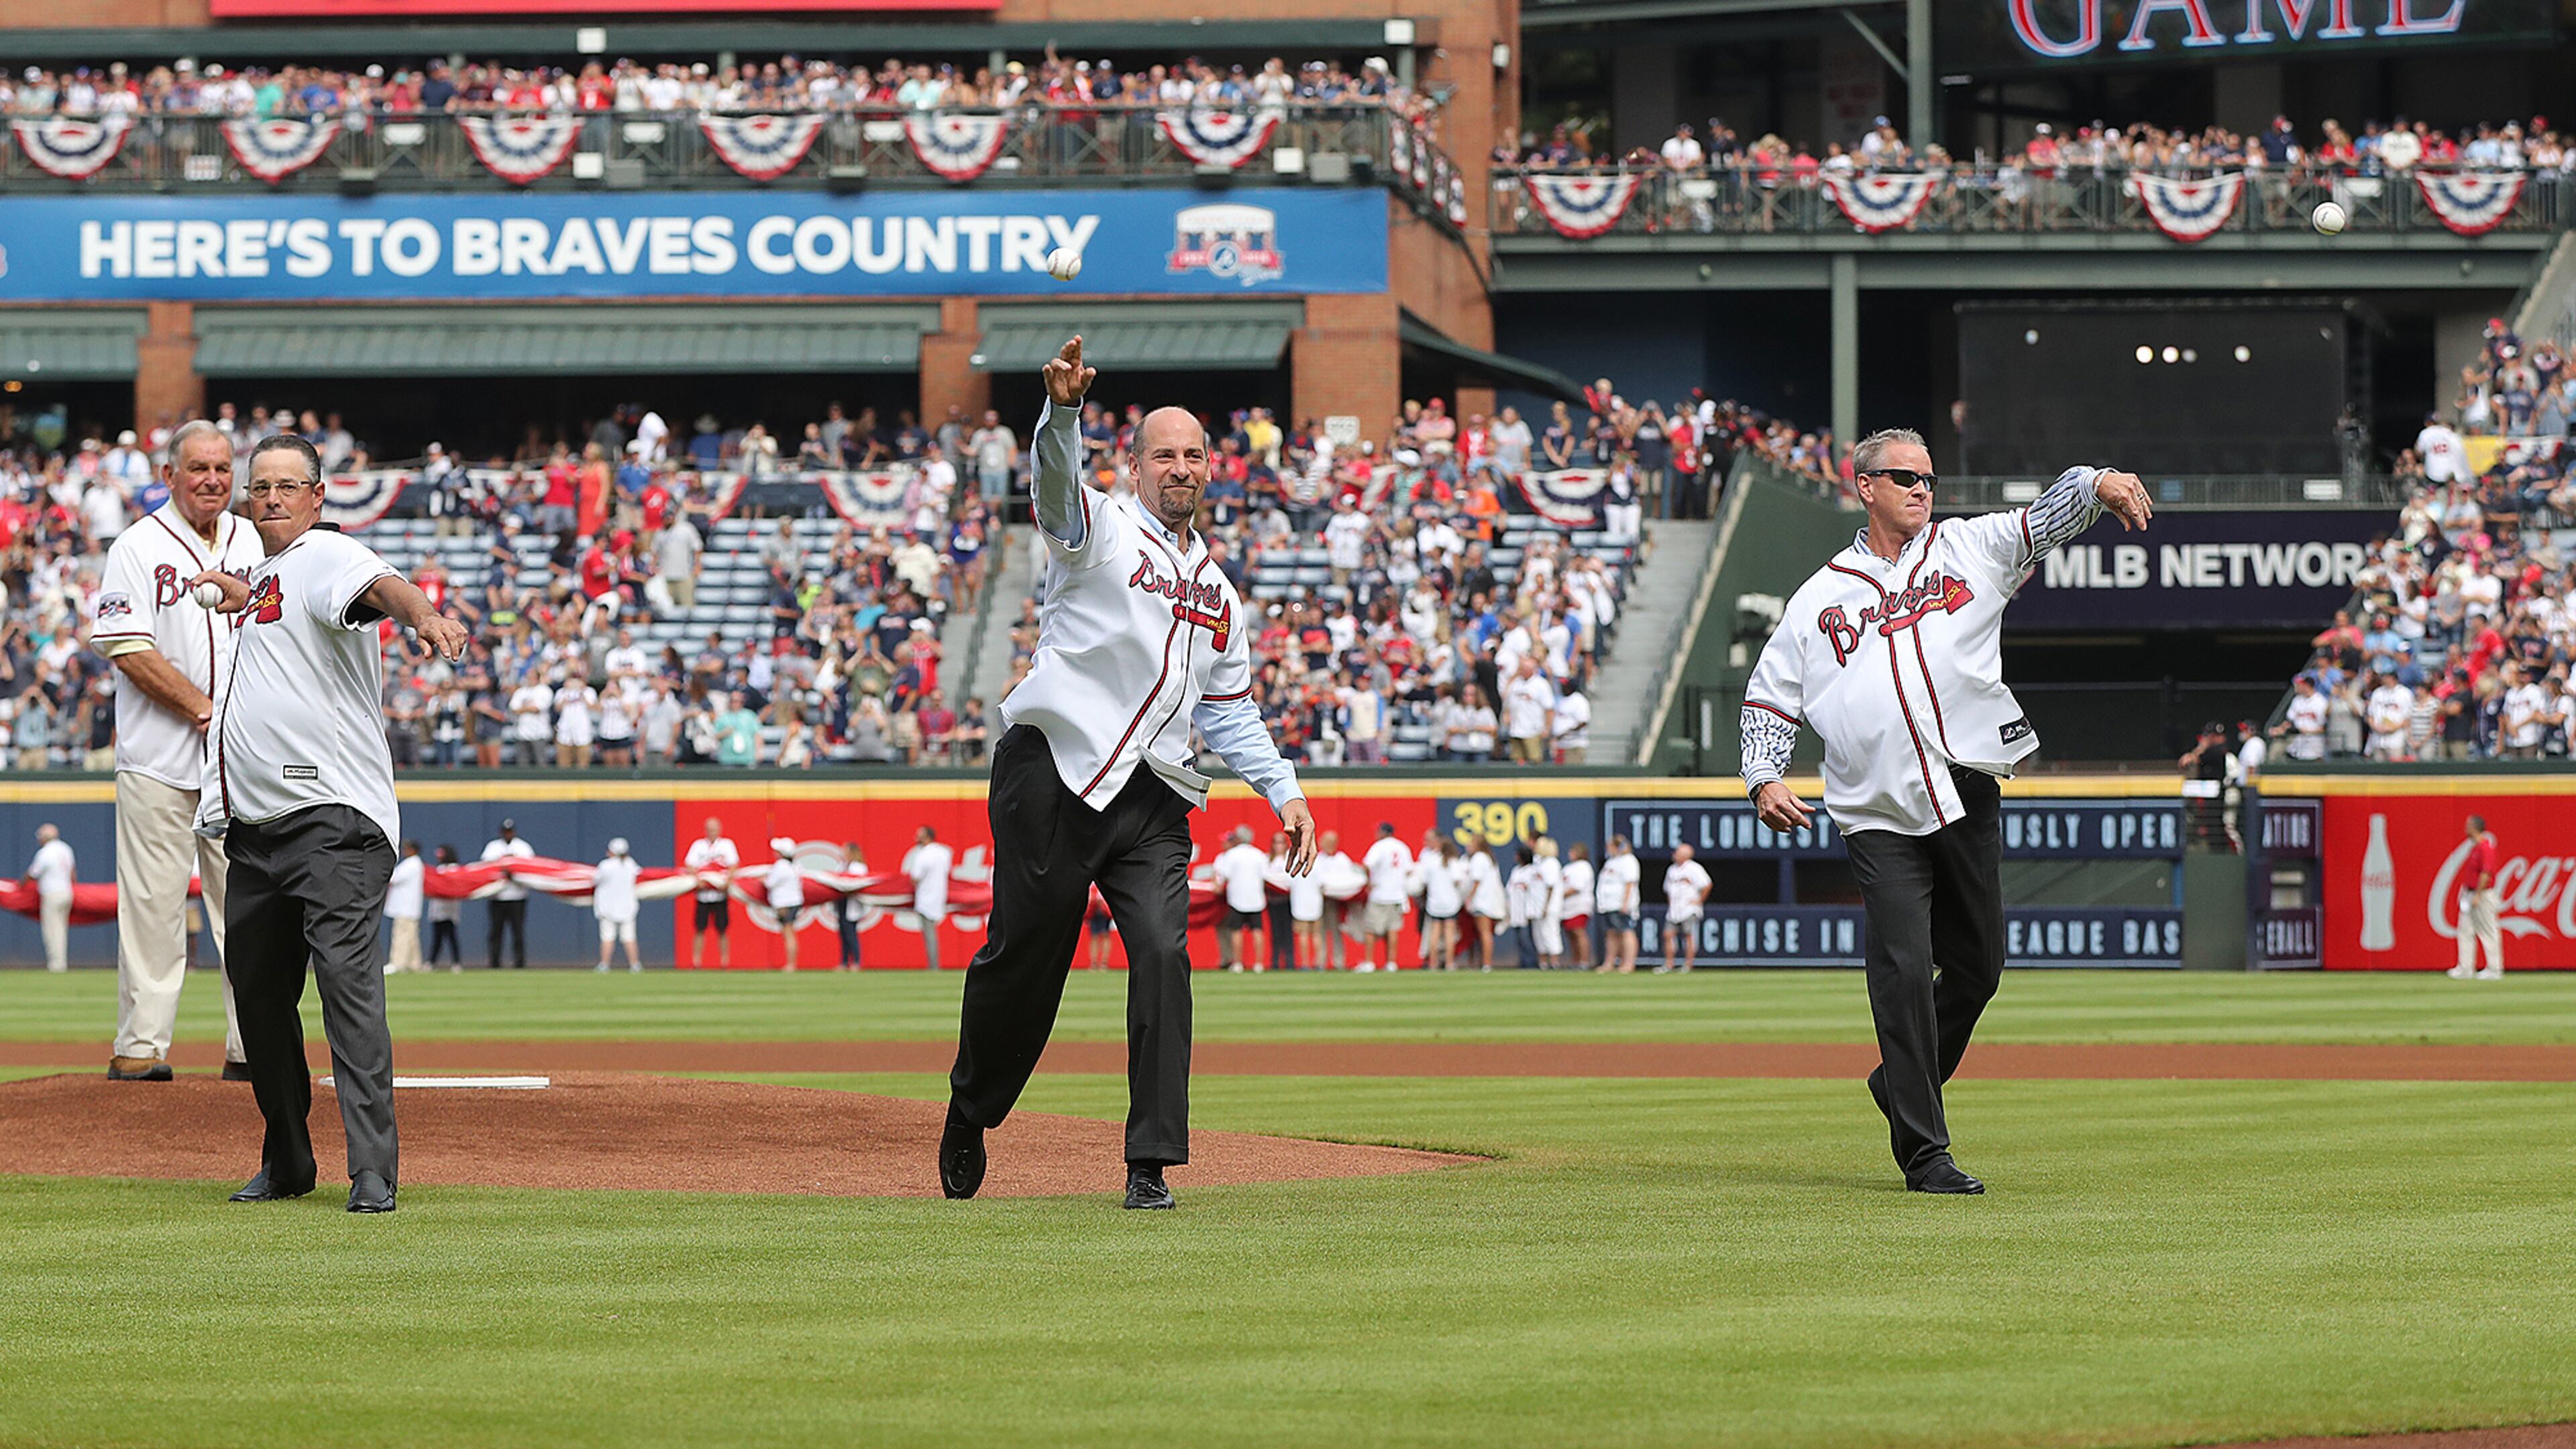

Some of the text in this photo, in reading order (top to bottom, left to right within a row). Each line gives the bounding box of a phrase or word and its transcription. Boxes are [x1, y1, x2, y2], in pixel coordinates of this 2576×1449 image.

[80, 215, 1099, 278] HERE'S TO BRAVES COUNTRY
[1128, 548, 1222, 611] Braves
[2044, 541, 2368, 589] MLB NETWOR
[1818, 570, 1941, 667] Braves
[1452, 801, 1549, 847] 390
[1630, 814, 1683, 849] THE
[2101, 813, 2177, 849] OPER
[1819, 919, 1856, 955] IN
[2006, 919, 2105, 956] EAGUE
[2123, 919, 2180, 955] BAS
